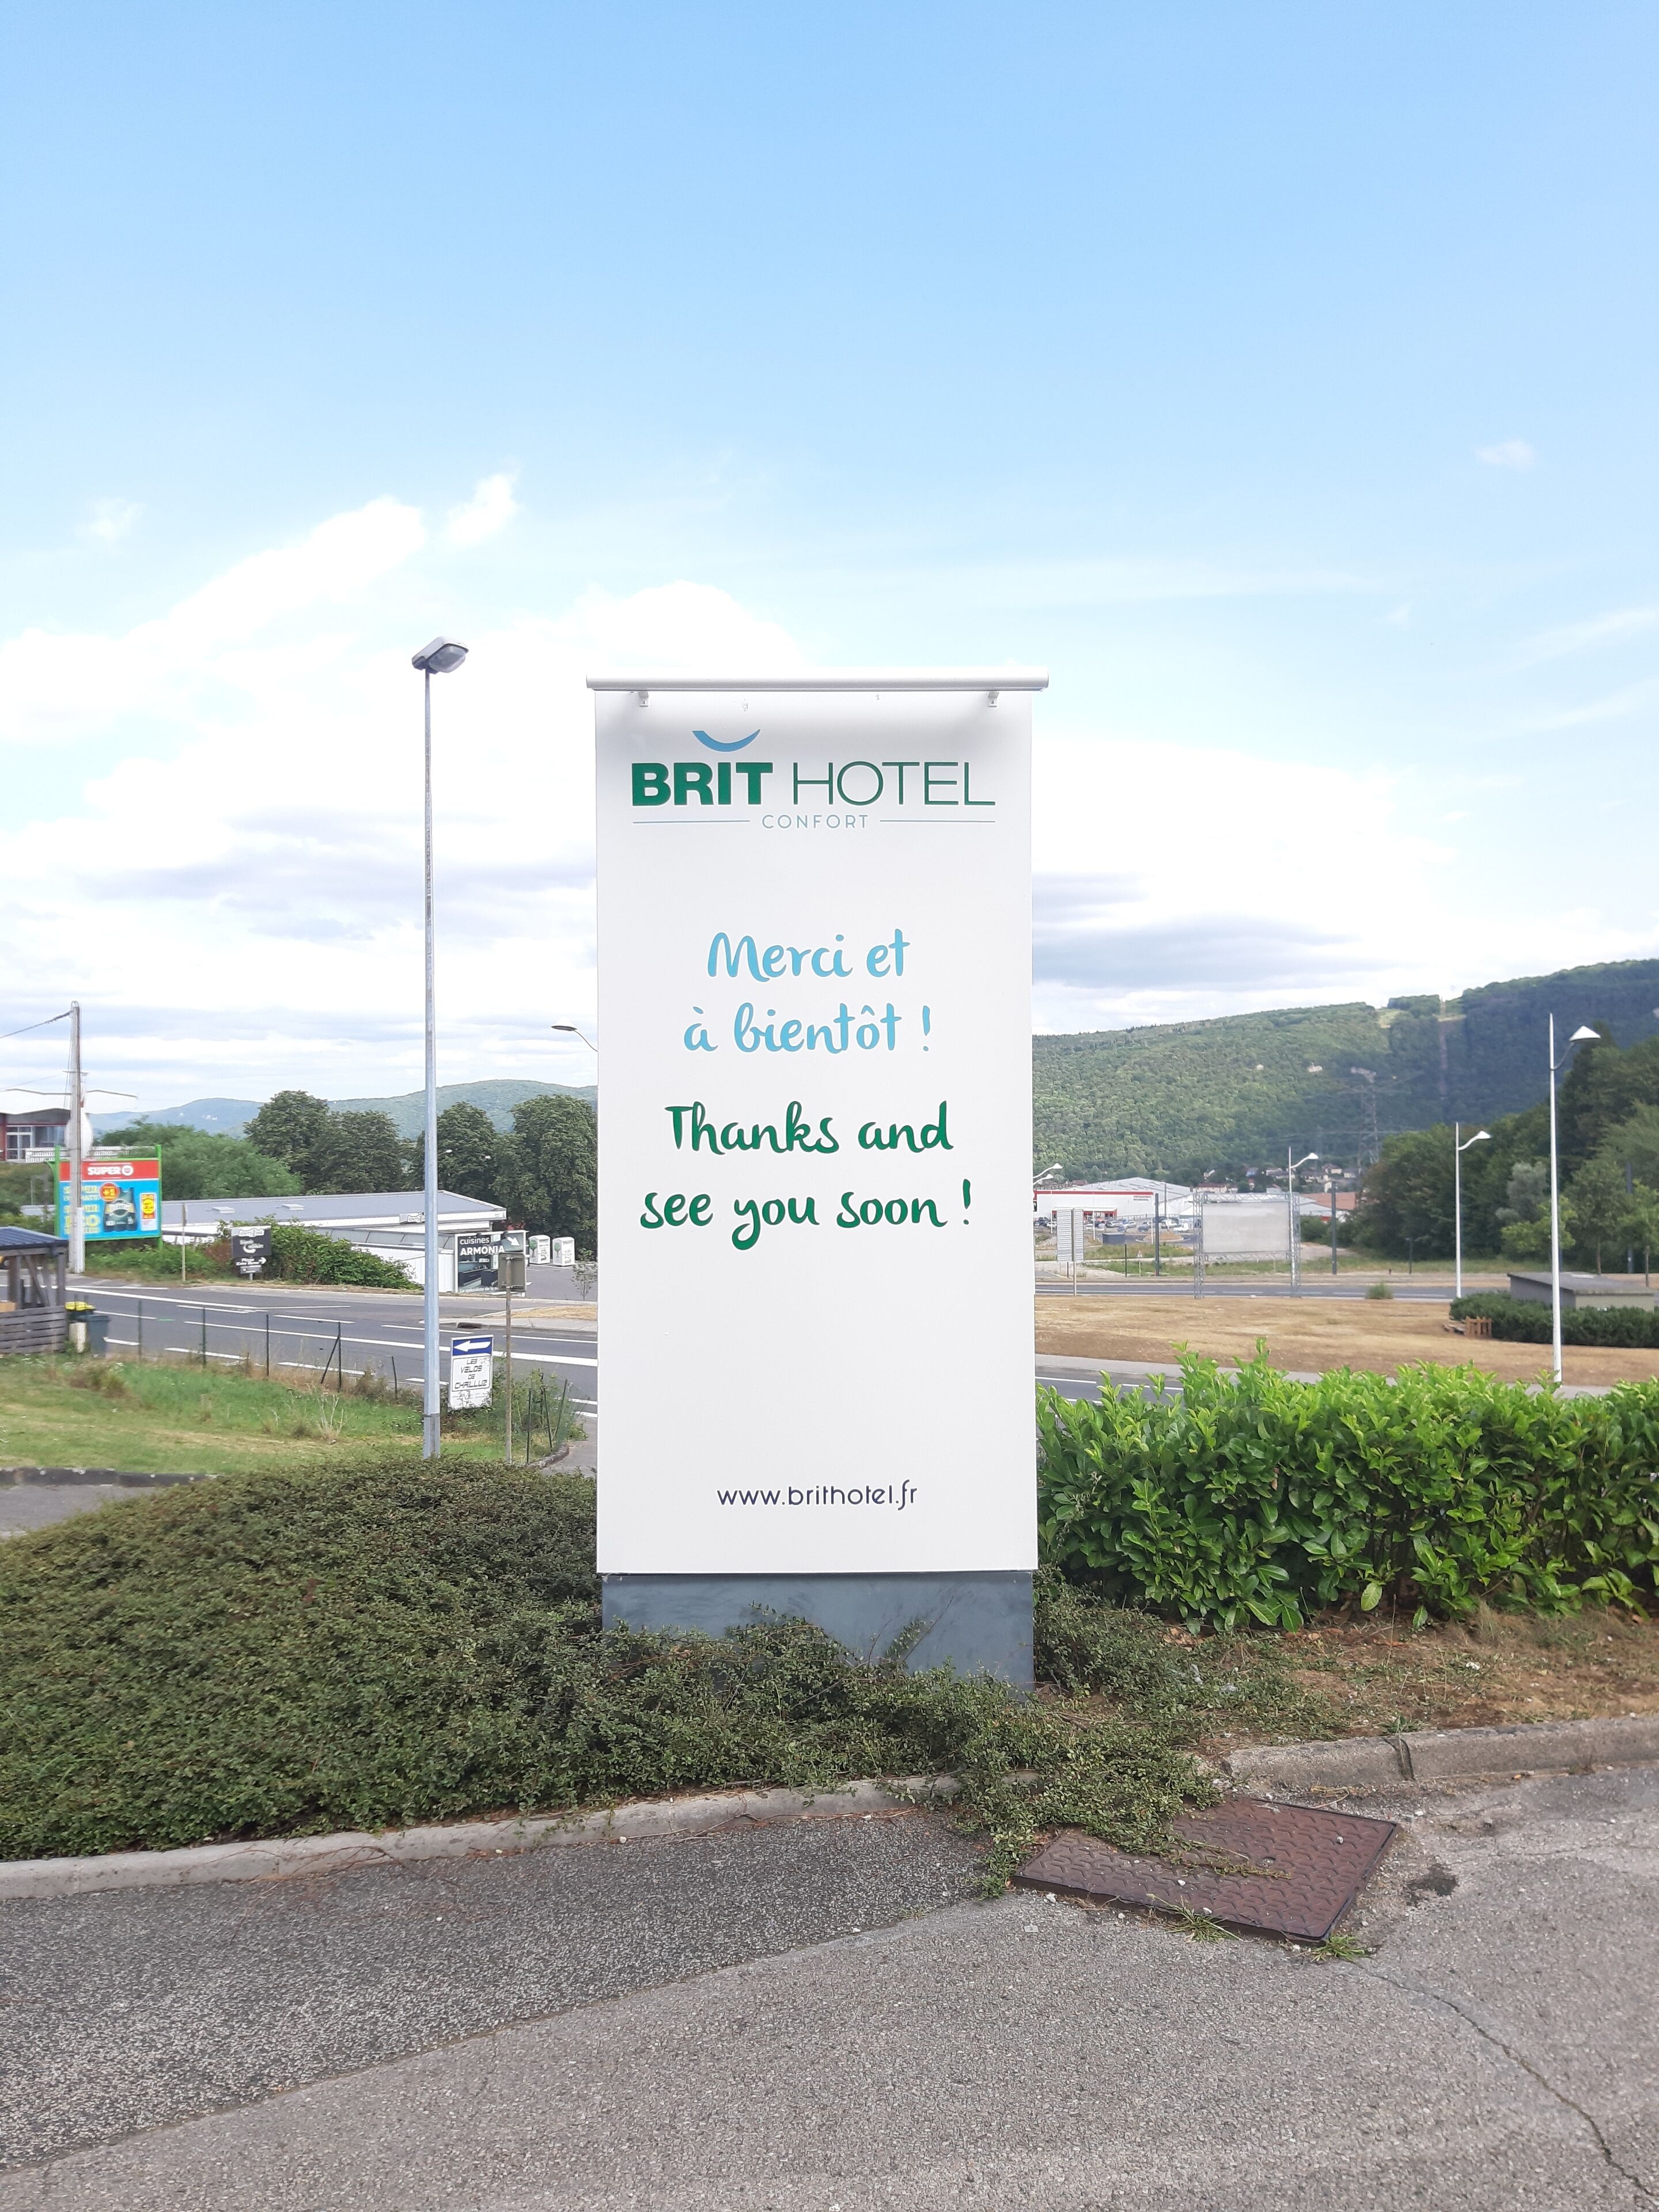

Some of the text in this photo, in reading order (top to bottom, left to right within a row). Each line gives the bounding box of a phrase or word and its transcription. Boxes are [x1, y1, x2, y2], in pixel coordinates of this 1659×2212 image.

[631, 760, 996, 806] BRIT HOTEL
[762, 814, 868, 829] CONFORT
[707, 928, 911, 983] Merci et
[683, 1002, 931, 1054] à bientôt !
[664, 1100, 955, 1156] Thanks and
[88, 1166, 122, 1175] SUPER
[639, 1178, 971, 1251] see you soon !
[460, 1236, 490, 1245] cuisines
[460, 1245, 505, 1256] ARMONIA
[717, 1479, 918, 1511] www.brithotel.fr
